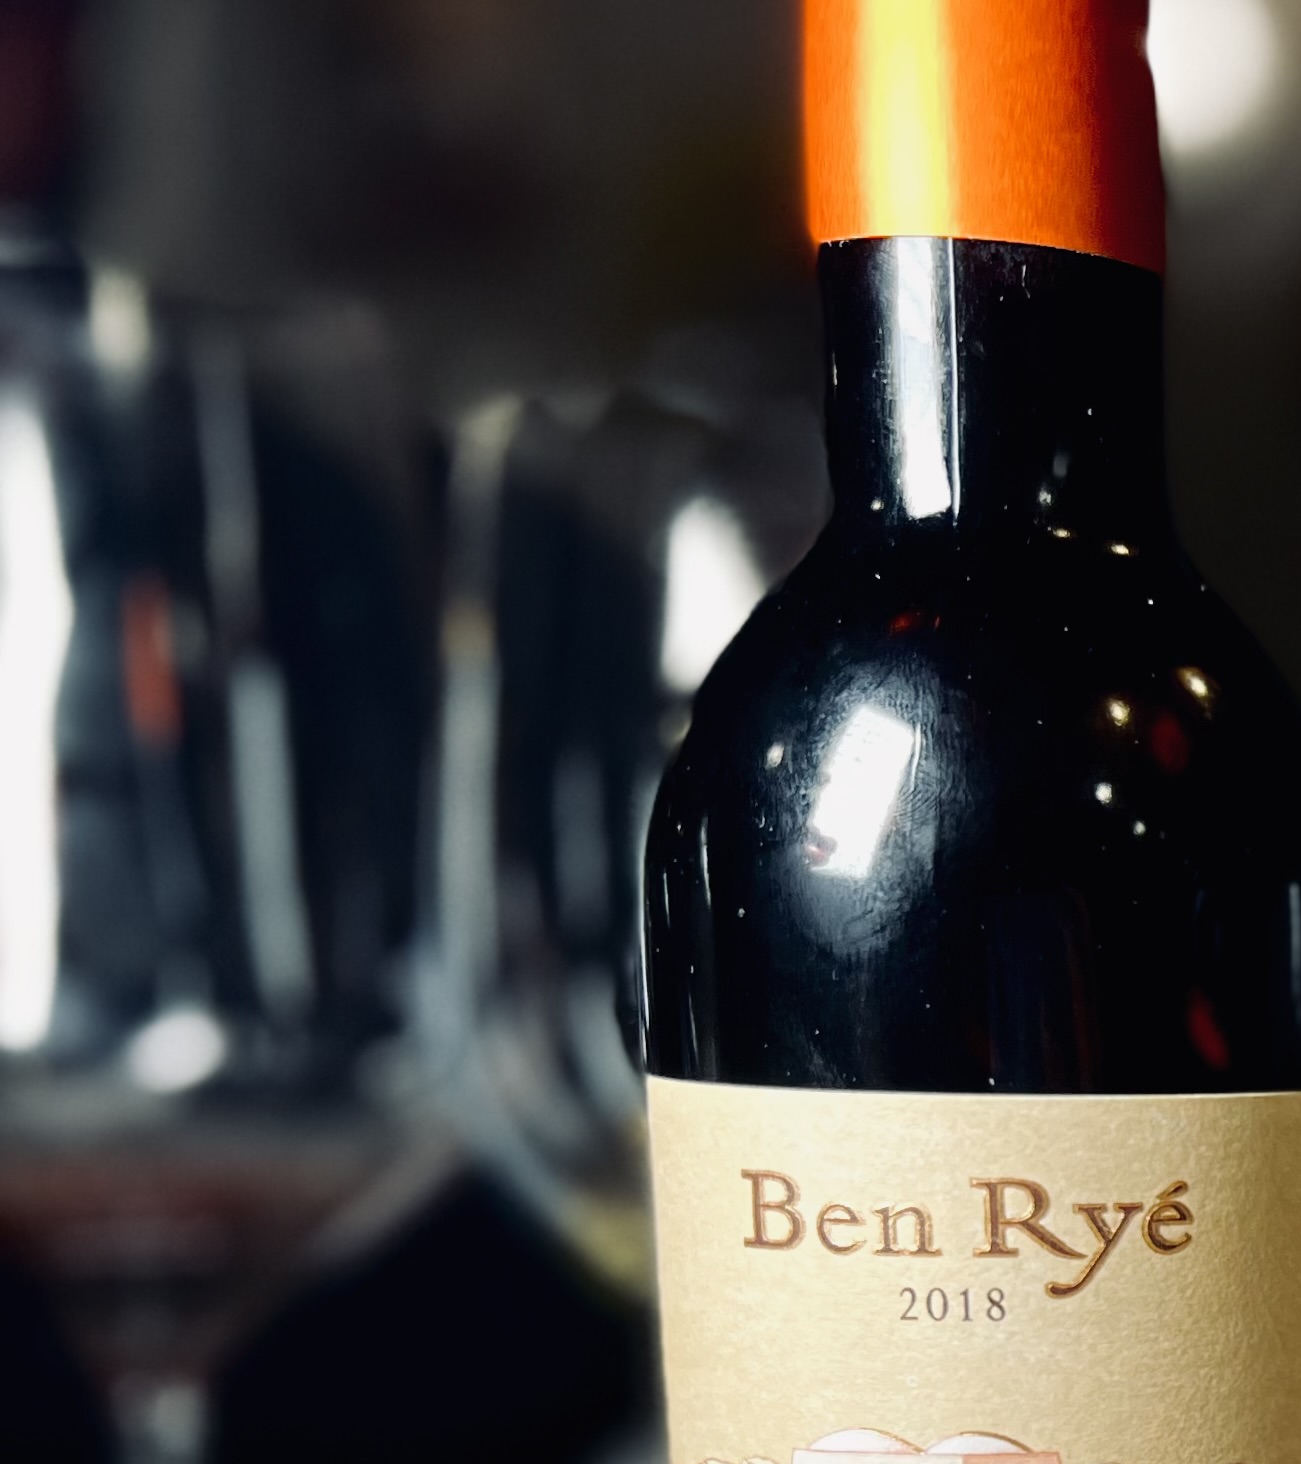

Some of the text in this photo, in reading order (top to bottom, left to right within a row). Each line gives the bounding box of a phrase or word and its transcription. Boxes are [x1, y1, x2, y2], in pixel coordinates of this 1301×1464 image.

[741, 1168, 1194, 1299] Ben Ryé
[899, 1286, 1007, 1322] 2018
